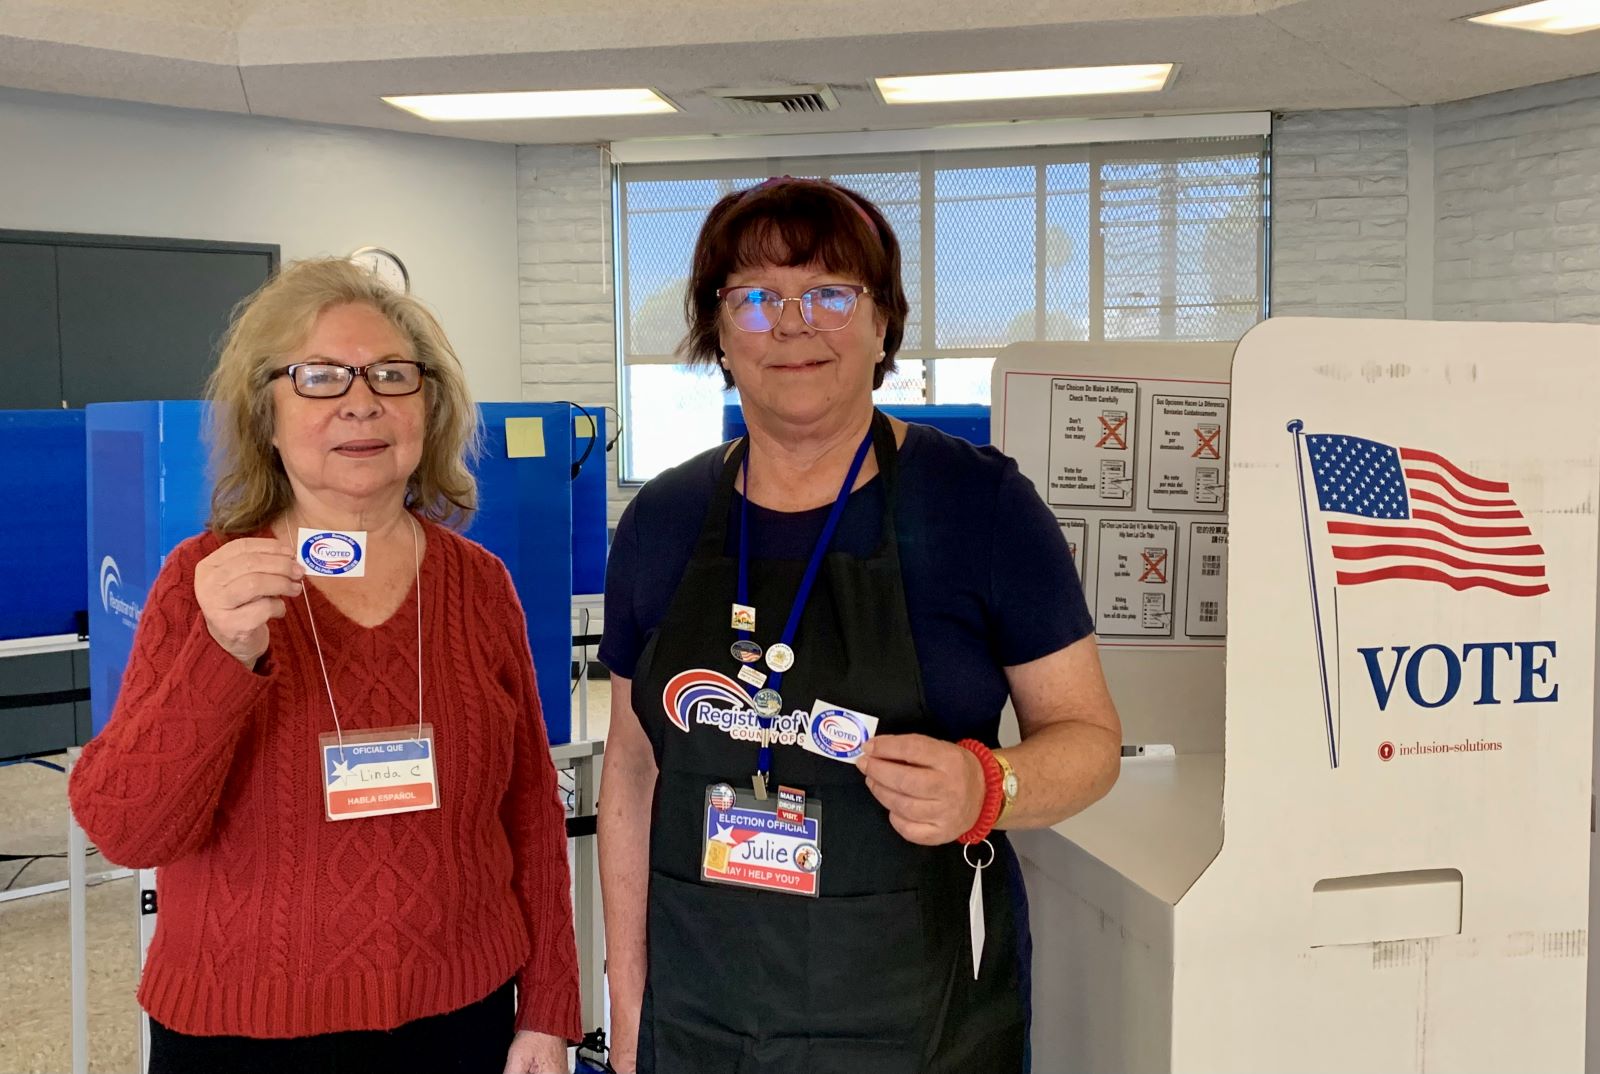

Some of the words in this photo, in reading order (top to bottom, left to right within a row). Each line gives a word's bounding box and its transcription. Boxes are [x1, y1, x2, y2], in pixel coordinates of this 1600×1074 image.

[1098, 396, 1119, 405] Carefully
[1357, 640, 1559, 711] VOTE
[780, 712, 800, 729] of
[732, 729, 777, 742] COUNY
[834, 730, 857, 741] VOTED
[352, 746, 385, 755] OFICIAL
[386, 744, 404, 752] QUE
[360, 766, 400, 782] Linda
[410, 765, 421, 776] C
[347, 796, 377, 805] HABLA
[378, 791, 416, 802] ESPAÑOL
[780, 792, 794, 801] MAIL
[795, 794, 803, 803] IT.
[779, 801, 793, 810] DROP
[782, 811, 799, 821] VISIT.
[719, 814, 765, 827] ELECTION
[767, 820, 809, 834] OFFICIAL
[741, 840, 788, 863] Julie
[748, 869, 773, 880] HELP
[775, 872, 800, 885] YOU?
